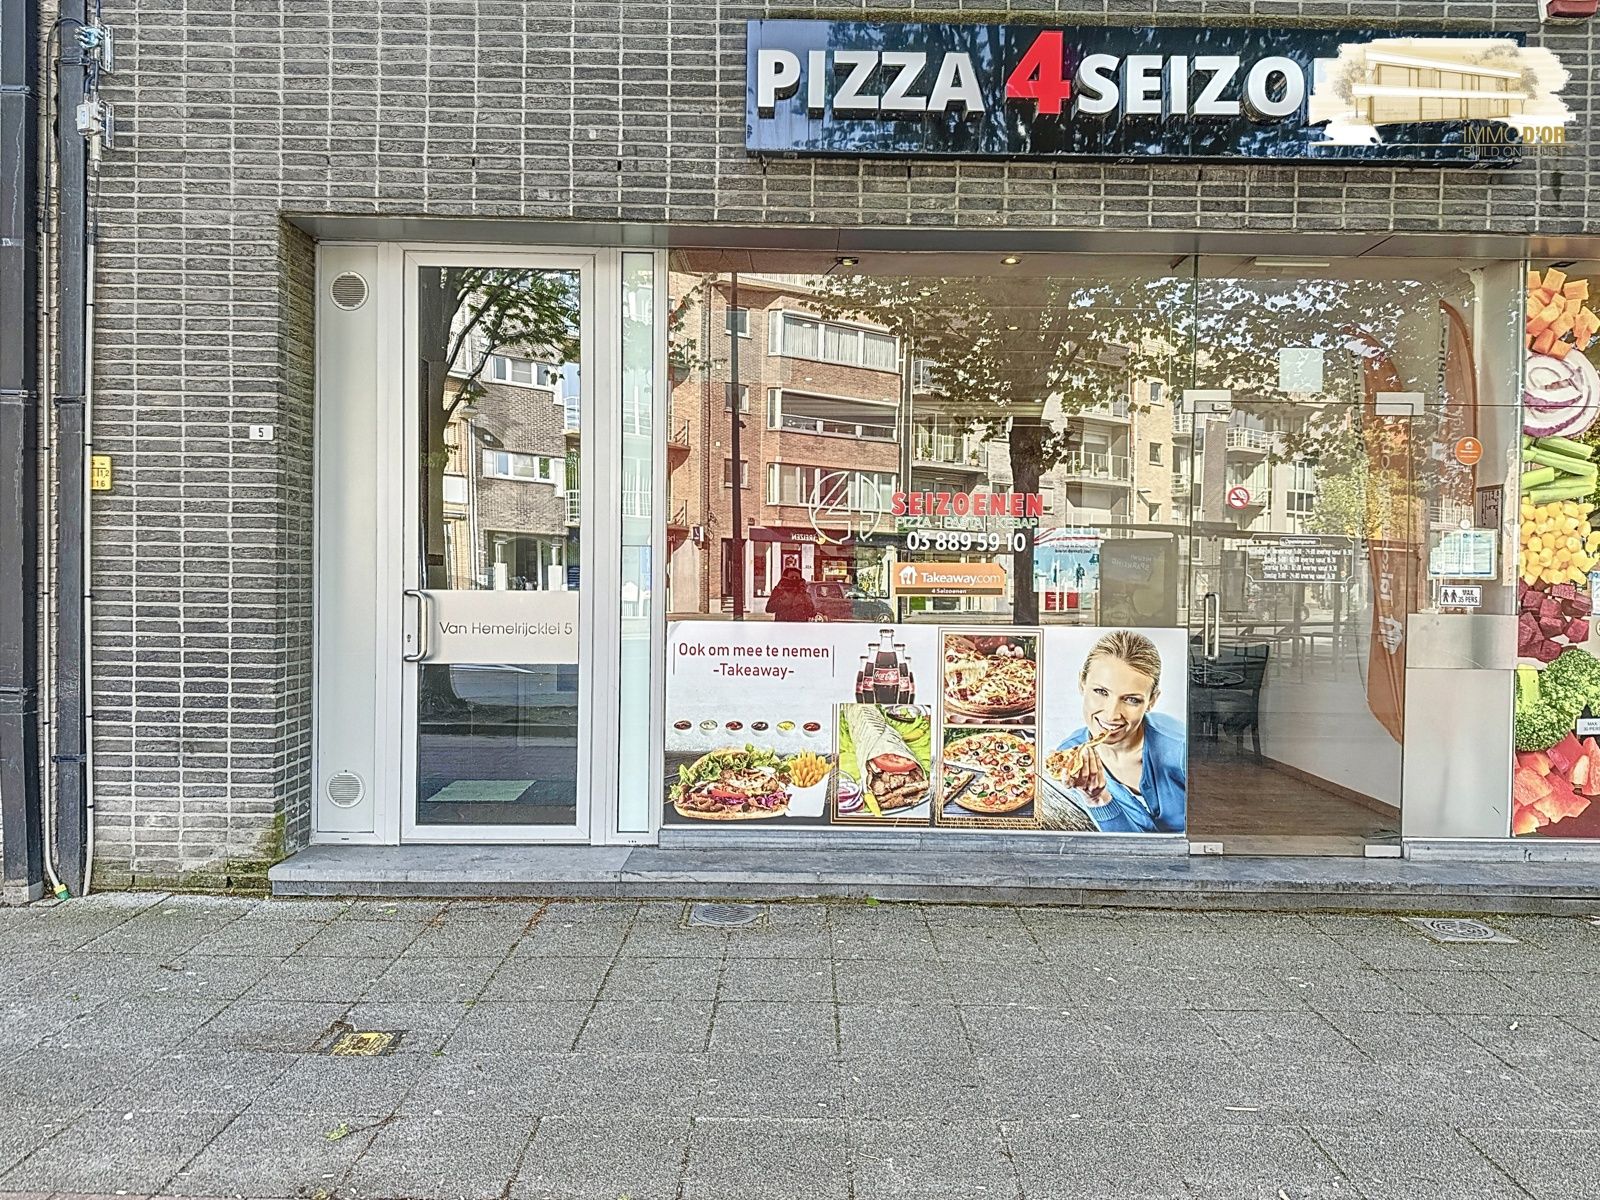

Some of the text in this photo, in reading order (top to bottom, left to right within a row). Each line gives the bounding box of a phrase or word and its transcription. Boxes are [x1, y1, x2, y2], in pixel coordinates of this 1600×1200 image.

[757, 49, 986, 113] PIZZA
[258, 427, 264, 438] 5
[891, 491, 1044, 517] SEIZOENEN
[895, 516, 932, 528] PIZZA
[944, 517, 983, 529] PASTA
[996, 517, 1038, 529] KEBAP
[907, 532, 1026, 553] 03 889 59 10
[921, 572, 1001, 587] Takeaway.com
[439, 621, 573, 637] Van Hemelrijcklei 5
[678, 642, 830, 658] Ook om mee te nemen
